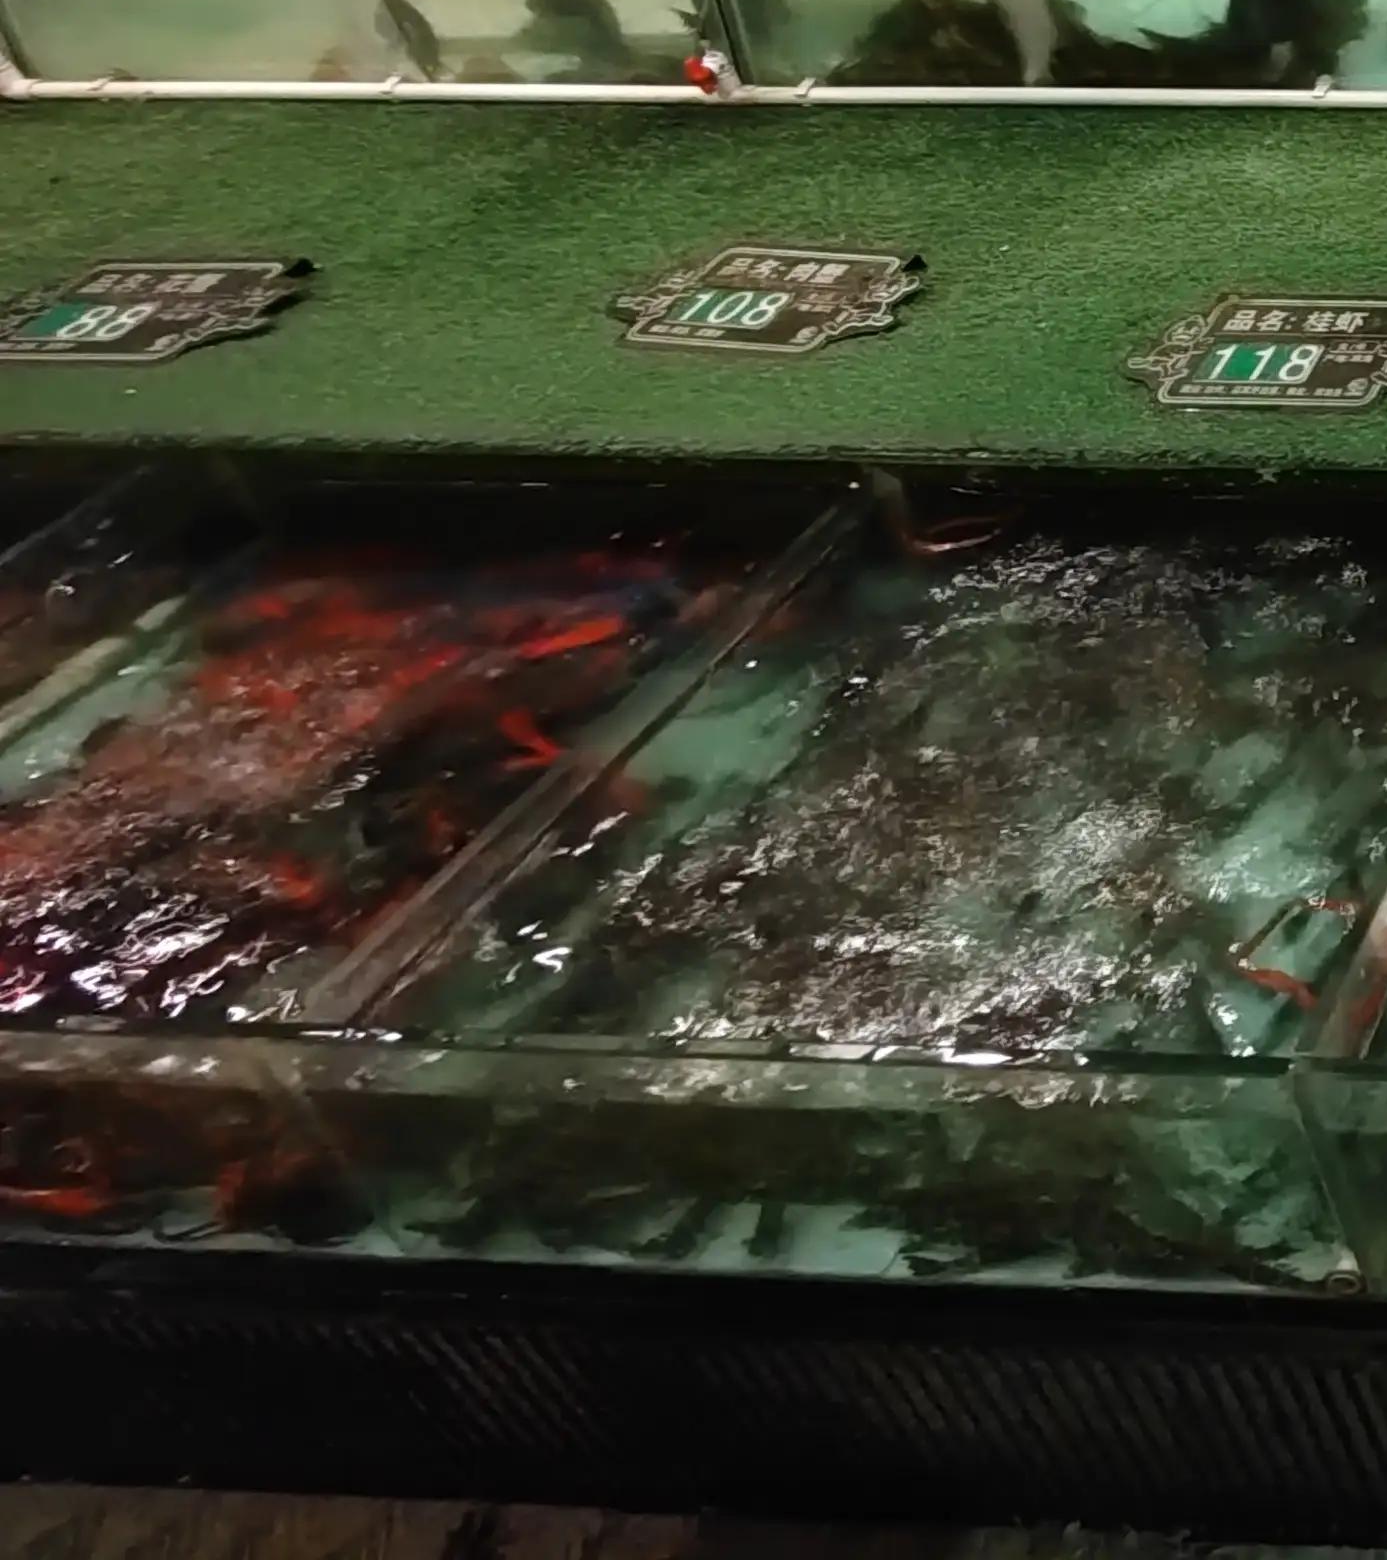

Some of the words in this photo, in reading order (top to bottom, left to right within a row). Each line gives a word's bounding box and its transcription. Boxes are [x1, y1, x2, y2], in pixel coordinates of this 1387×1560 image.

[56, 301, 161, 340] 88
[680, 291, 791, 326] 108
[1208, 343, 1320, 382] 118
